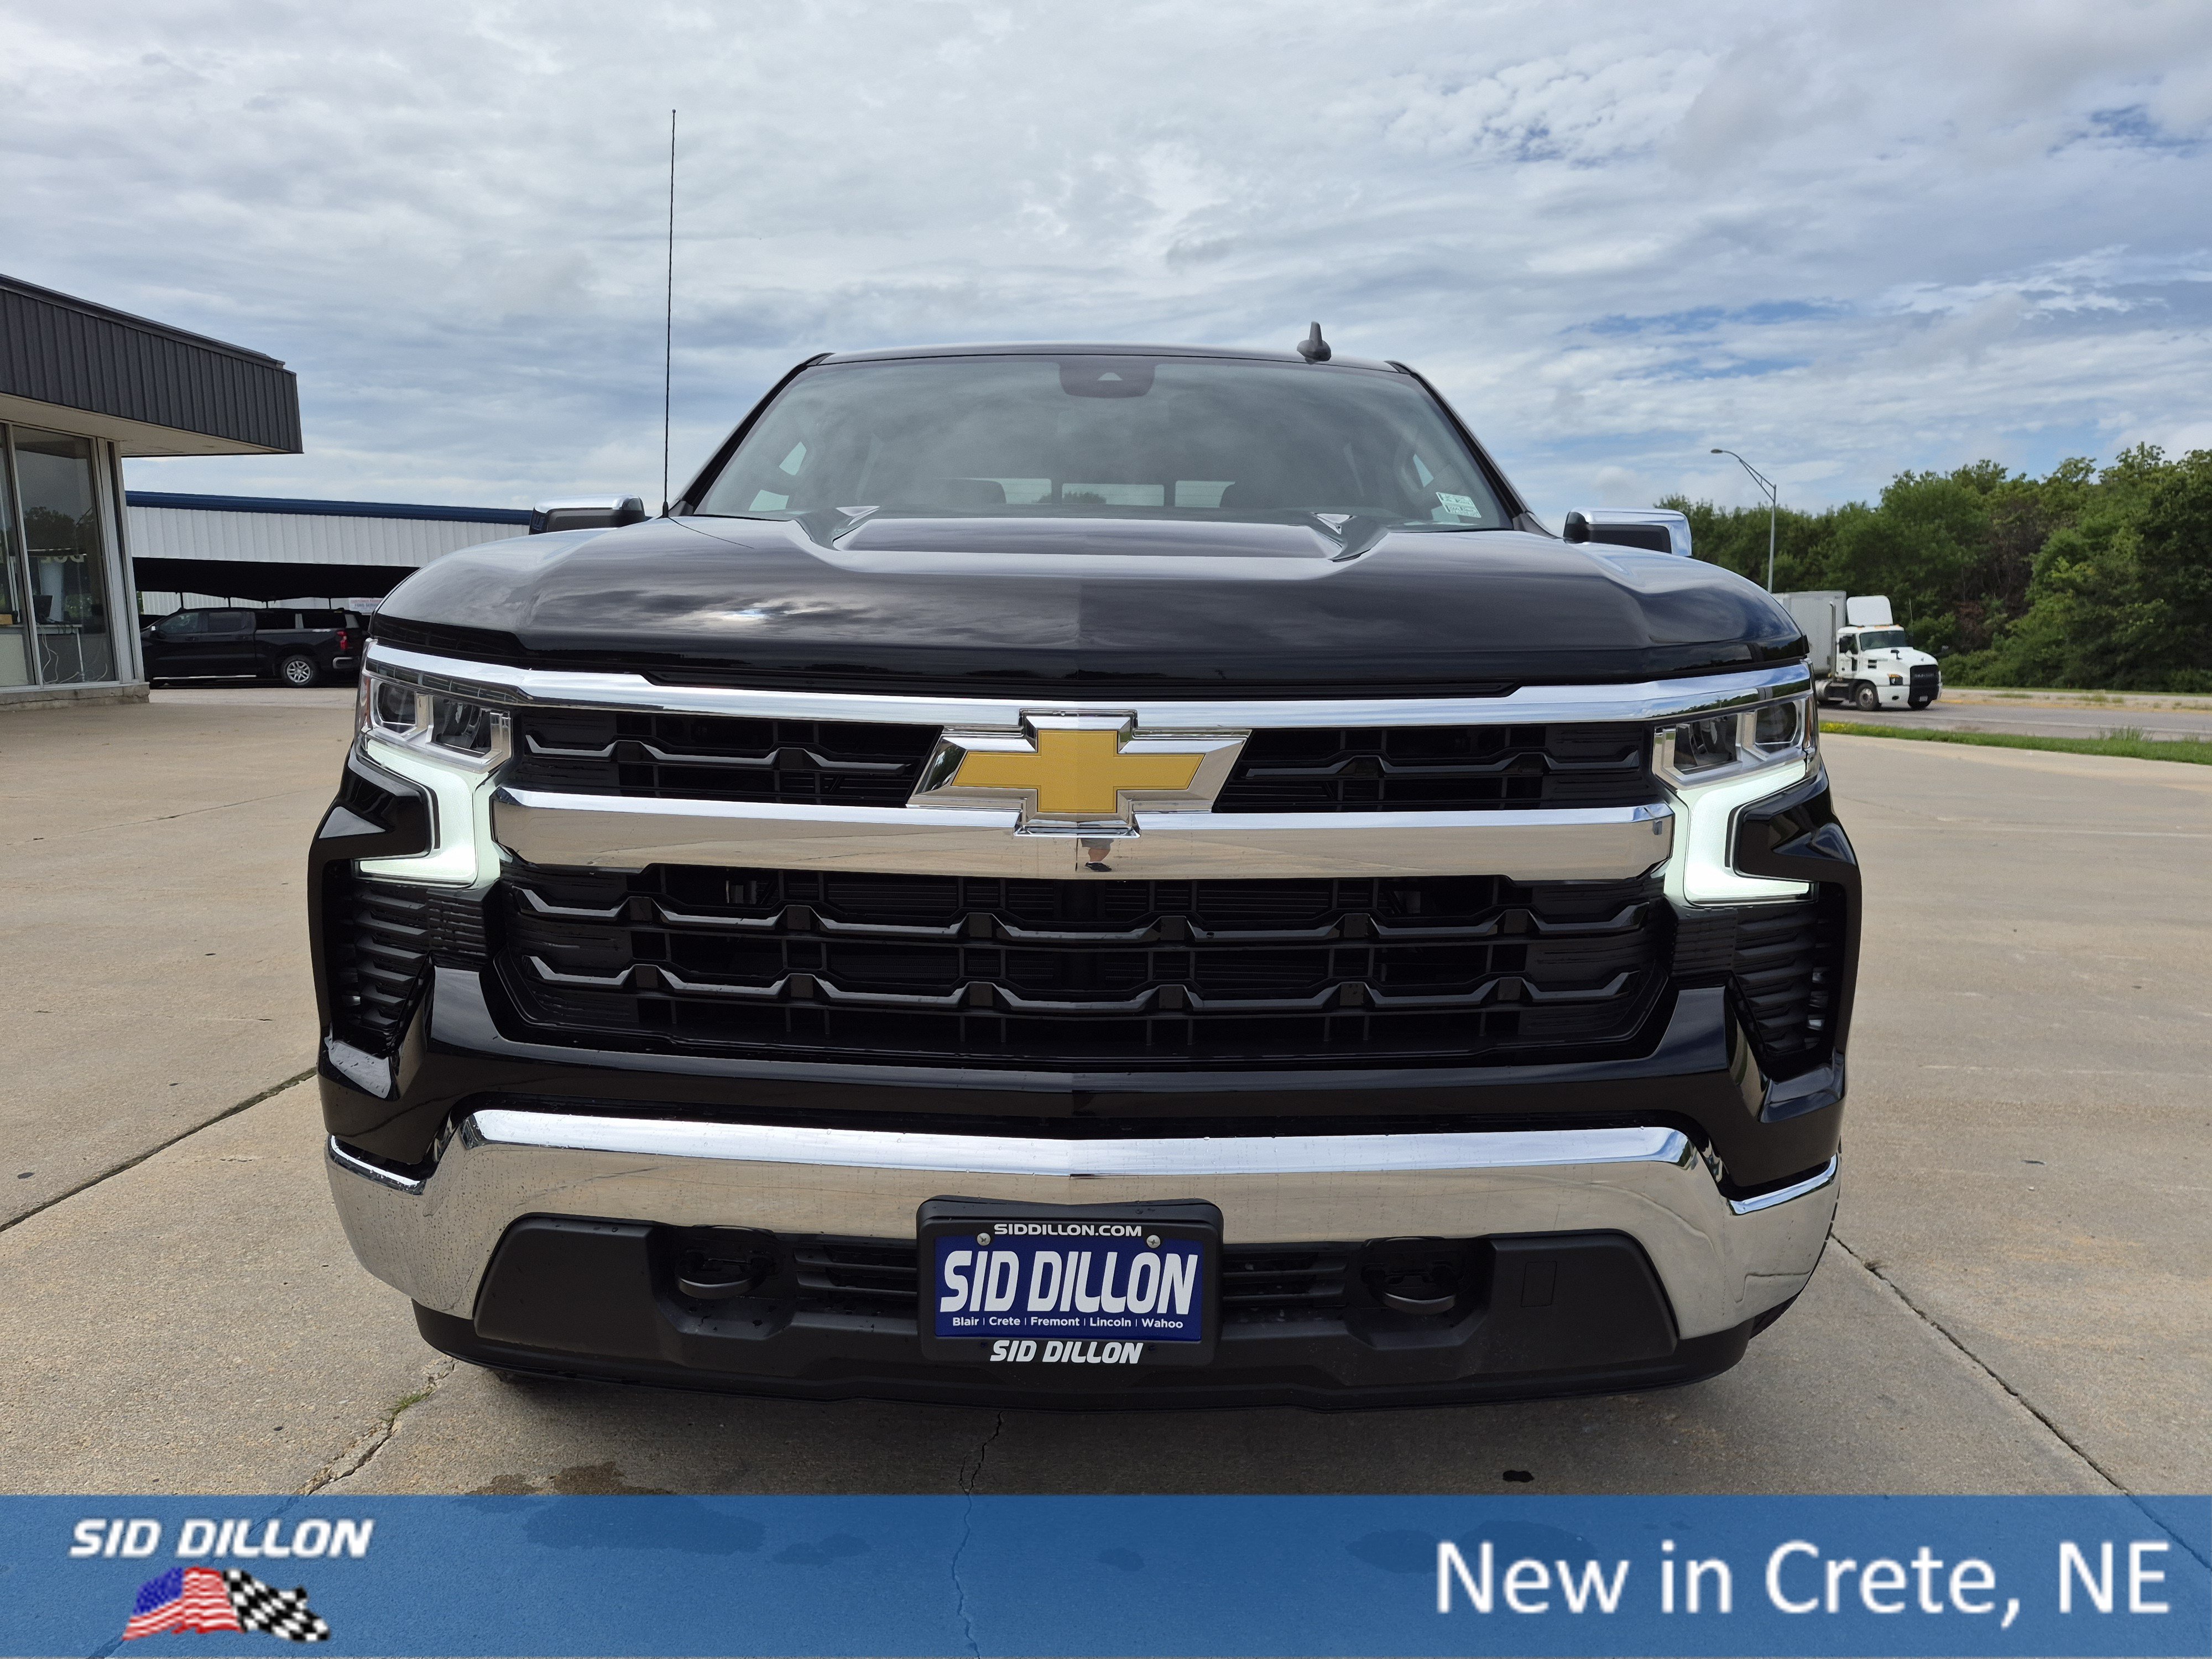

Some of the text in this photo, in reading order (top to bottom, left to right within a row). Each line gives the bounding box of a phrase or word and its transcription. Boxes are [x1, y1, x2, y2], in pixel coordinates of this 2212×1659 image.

[994, 1223, 1142, 1237] SIDDILLON.COM
[940, 1250, 1198, 1315] SID DILLON
[952, 1316, 1183, 1329] Blair Crete Fremont Lincoln Wahoo
[989, 1340, 1144, 1364] SID DILLON
